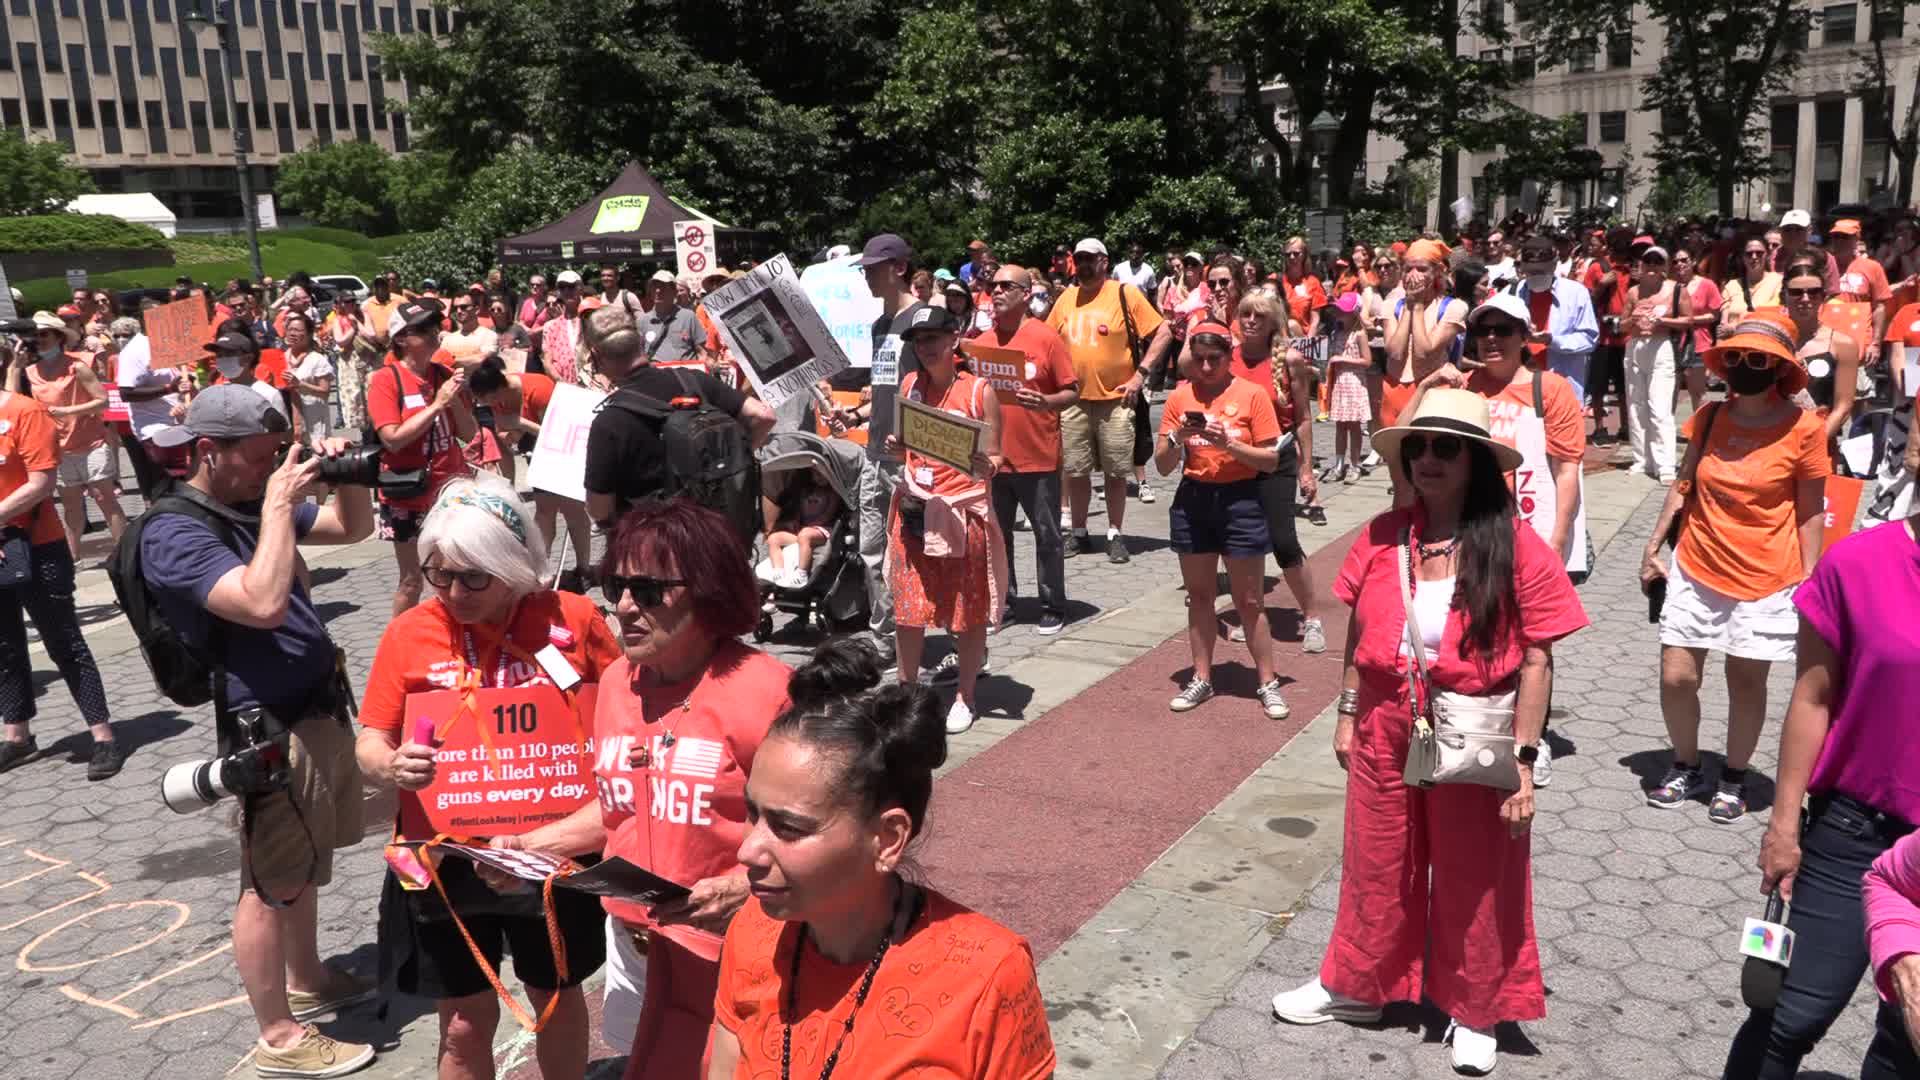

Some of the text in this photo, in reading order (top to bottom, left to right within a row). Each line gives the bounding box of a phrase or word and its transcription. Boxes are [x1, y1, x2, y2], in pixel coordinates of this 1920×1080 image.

[703, 286, 735, 313] NOW
[981, 359, 1017, 378] gun
[541, 406, 590, 456] LIF
[492, 702, 538, 734] 110
[519, 742, 547, 758] 110
[552, 738, 594, 760] peol
[593, 735, 670, 772] WER
[448, 760, 578, 784] are klled with
[437, 782, 589, 810] guns every day.
[596, 776, 715, 826] ORNGE
